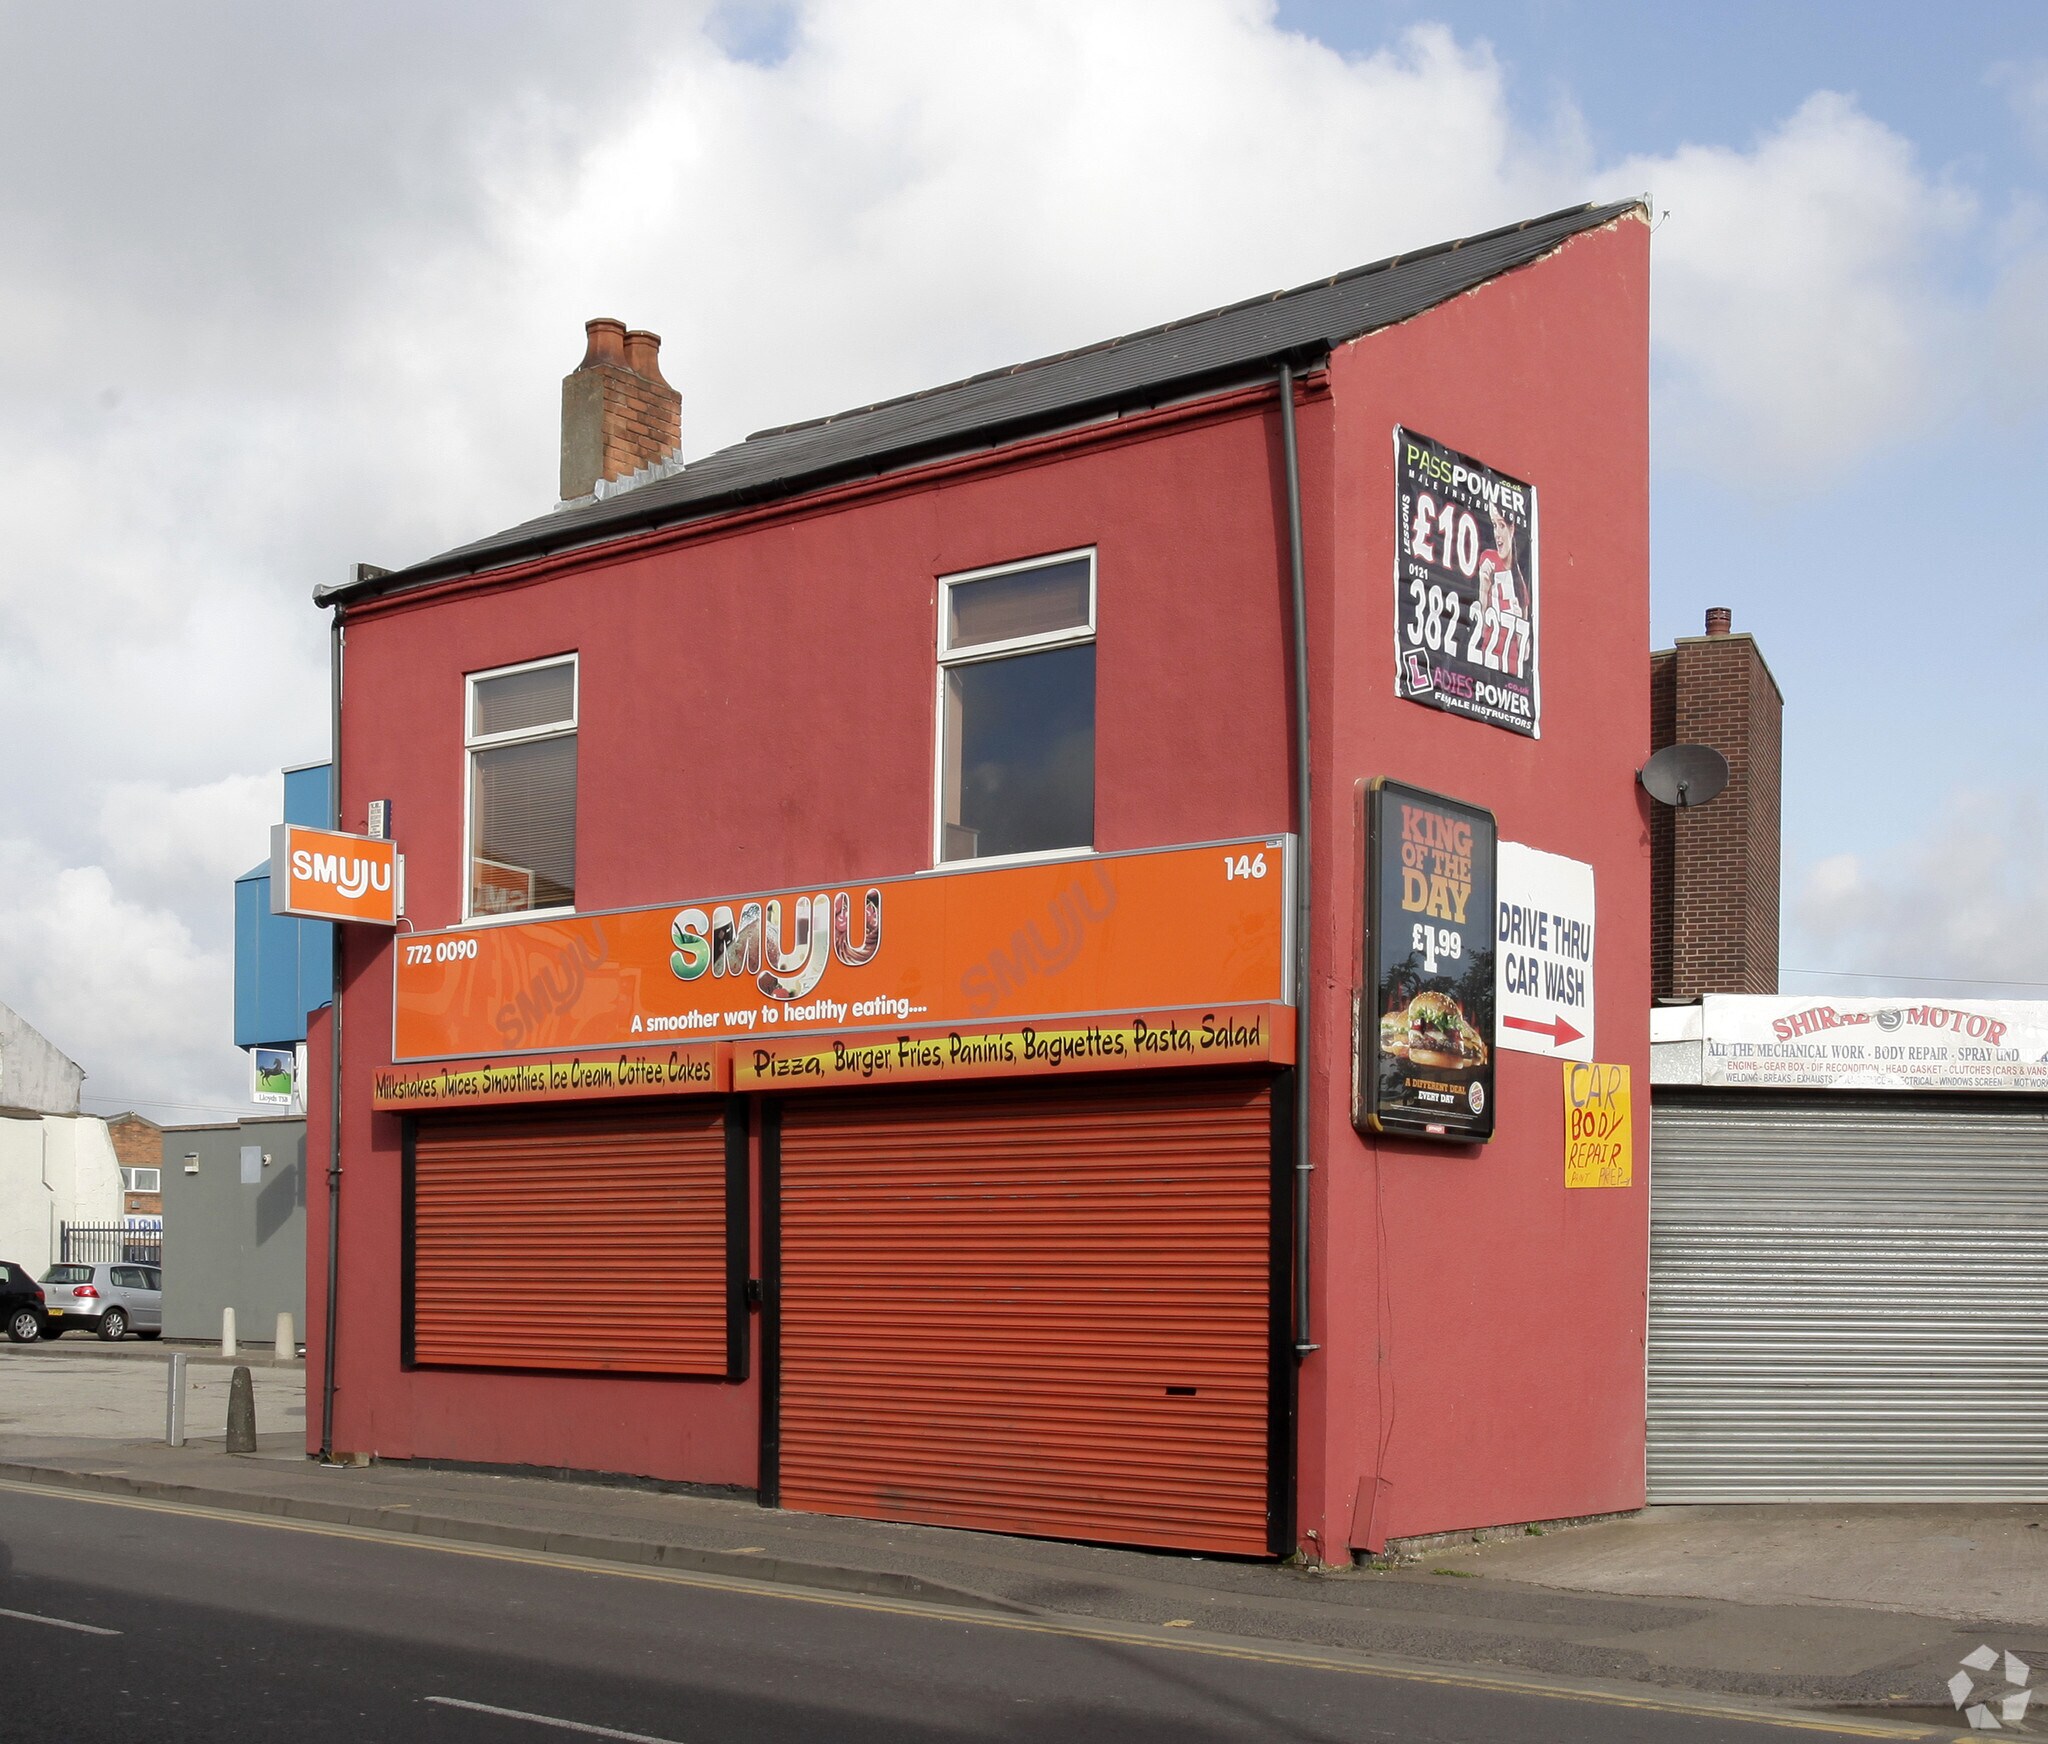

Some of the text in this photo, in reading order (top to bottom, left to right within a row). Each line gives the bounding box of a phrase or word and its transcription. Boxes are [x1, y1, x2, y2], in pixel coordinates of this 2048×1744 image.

[1407, 443, 1526, 516] PASSPOWER
[1408, 469, 1528, 528] MALE INSTRUTORS
[1401, 494, 1411, 556] LESSONS
[1412, 494, 1479, 577] £10
[1408, 563, 1429, 580] 0121
[1407, 578, 1530, 679] 382 2277
[1471, 703, 1532, 730] INSTRUCTORS
[1475, 680, 1532, 718] POWER
[1401, 804, 1472, 857] KING
[293, 850, 391, 899] SMUJU
[1224, 853, 1268, 881] 146
[1402, 841, 1471, 883] OF THE
[1402, 866, 1472, 924] DAY
[406, 938, 479, 965] 772 0090
[670, 888, 882, 1001] SMUJU
[959, 861, 1119, 1016] SMUJU
[1412, 923, 1461, 974] £1.99
[1499, 901, 1591, 963] DRIVE THRU
[495, 919, 609, 1048] SMUJU
[1505, 952, 1585, 1008] CAR WASH
[630, 1014, 643, 1033] A
[646, 1009, 720, 1032] smoother
[723, 1009, 757, 1029] way
[761, 1004, 779, 1023] to
[783, 999, 848, 1023] healthy
[1906, 1004, 2008, 1047] MOTOR
[753, 1013, 1261, 1079] Pizza, Burger, Fries, Paninis, Baguettes, Pasta, Salad
[1707, 1042, 1728, 1057] ALL
[1731, 1042, 1755, 1057] THE
[1756, 1043, 1828, 1059] MECHANICAL
[1831, 1045, 1865, 1060] WORK
[1874, 1046, 1905, 1061] BODY
[1908, 1047, 1948, 1061] REPAIR
[1957, 1047, 1993, 1062] SPRAY
[1727, 1060, 1758, 1071] ENGINE
[1763, 1061, 1788, 1072] GEAR
[1789, 1062, 1805, 1072] BOX
[1886, 1064, 1908, 1074] HEAD
[1909, 1064, 1943, 1075] GASKET
[1949, 1065, 1991, 1075] CLUTCHES
[1992, 1065, 2018, 1076] (CARS
[2019, 1066, 2025, 1076] &
[375, 1051, 711, 1101] Milkshakes, Juices, Smoothies, Ice Cream, Coffee, Cakes
[1412, 1078, 1449, 1093] DIFFERENT
[1449, 1084, 1467, 1096] DEAL
[1440, 1093, 1455, 1104] DAY
[1570, 1063, 1622, 1111] CAR
[1726, 1073, 1758, 1083] WELDING
[1763, 1073, 1792, 1083] BREAKS
[1796, 1074, 1833, 1084] EXHAUSTS
[1939, 1077, 1975, 1086] WINDOWS
[1975, 1077, 2003, 1087] SCREEN
[2013, 1078, 2029, 1087] MOT
[1571, 1107, 1624, 1141] BODY
[1568, 1142, 1622, 1169] REPAIR
